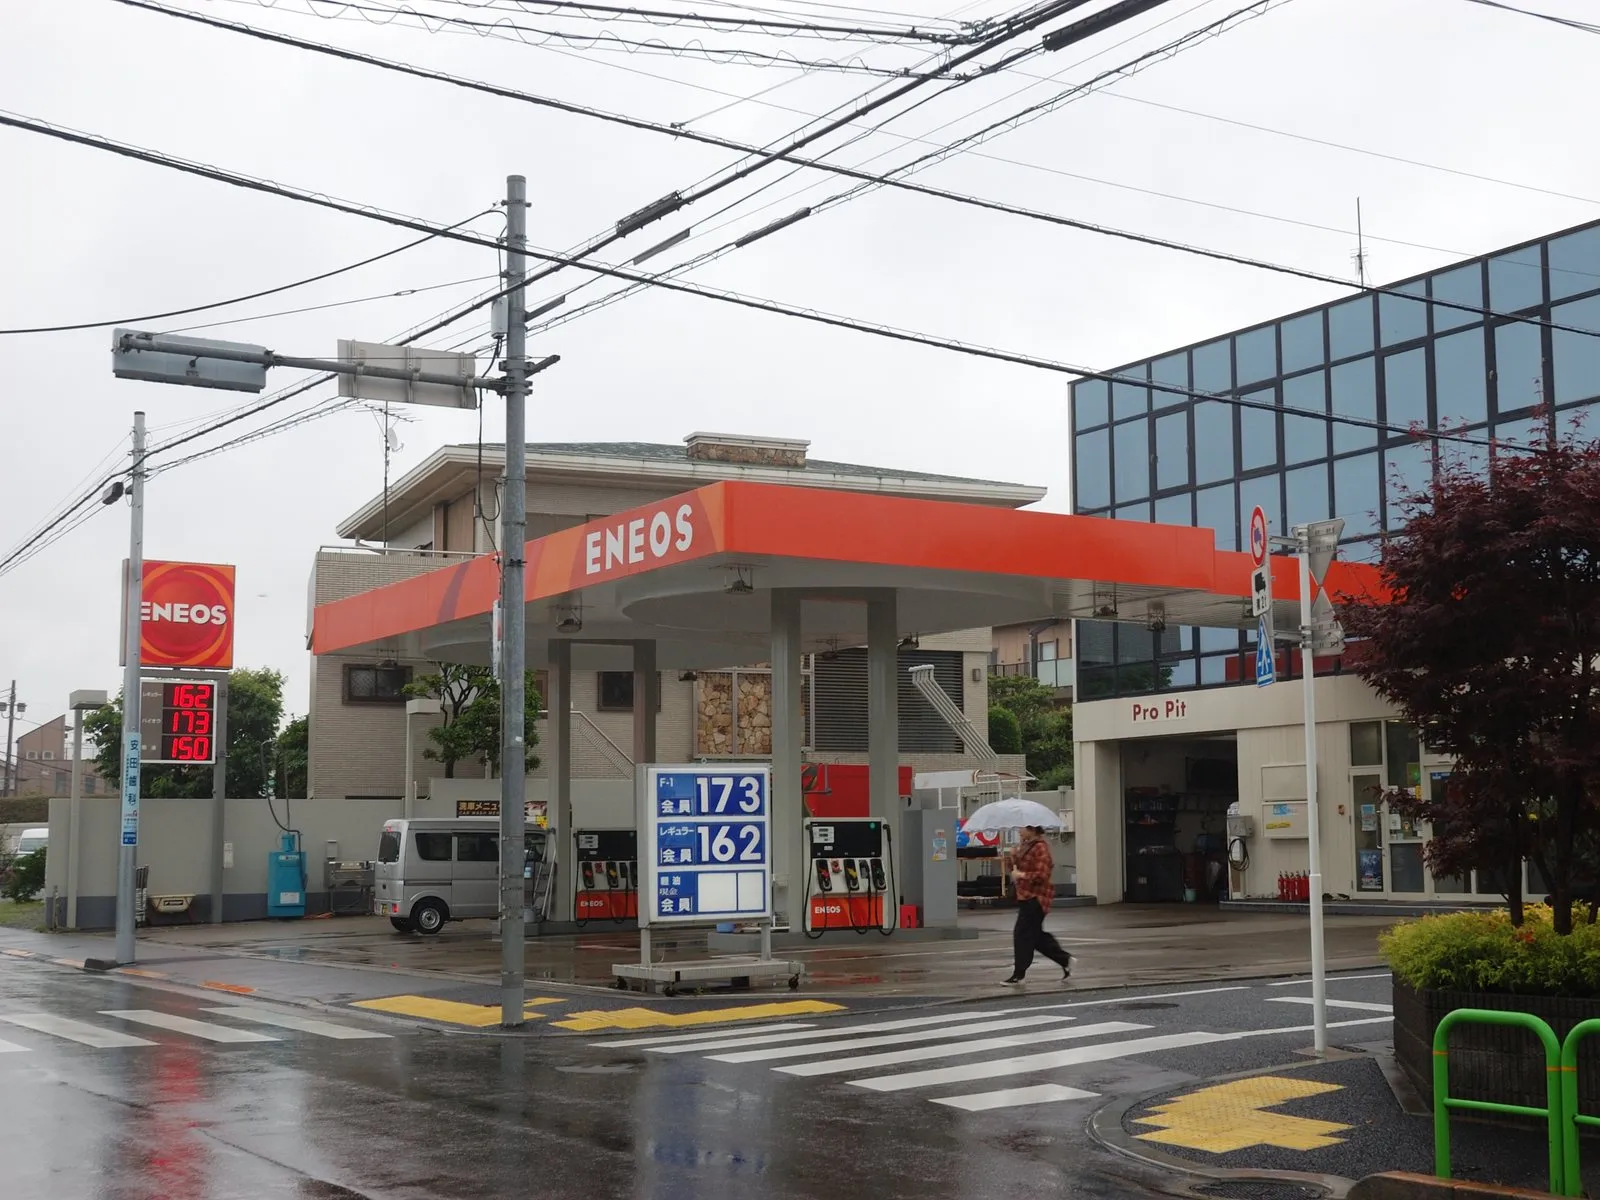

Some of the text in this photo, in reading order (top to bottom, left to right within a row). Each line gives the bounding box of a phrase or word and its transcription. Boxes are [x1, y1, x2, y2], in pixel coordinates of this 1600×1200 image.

[586, 503, 693, 575] ENEOS
[140, 601, 227, 625] ENEOS
[173, 685, 210, 708] 162
[1133, 699, 1186, 721] Pro Pit
[172, 711, 209, 734] 173
[171, 736, 209, 760] 150
[659, 777, 674, 787] F-1
[696, 776, 761, 813] 173
[661, 799, 691, 814] 会員
[659, 826, 695, 836] レギュラー
[697, 824, 762, 862] 162
[662, 849, 692, 863] 会員
[661, 897, 691, 912] 会員
[814, 906, 841, 914] ENEOS
